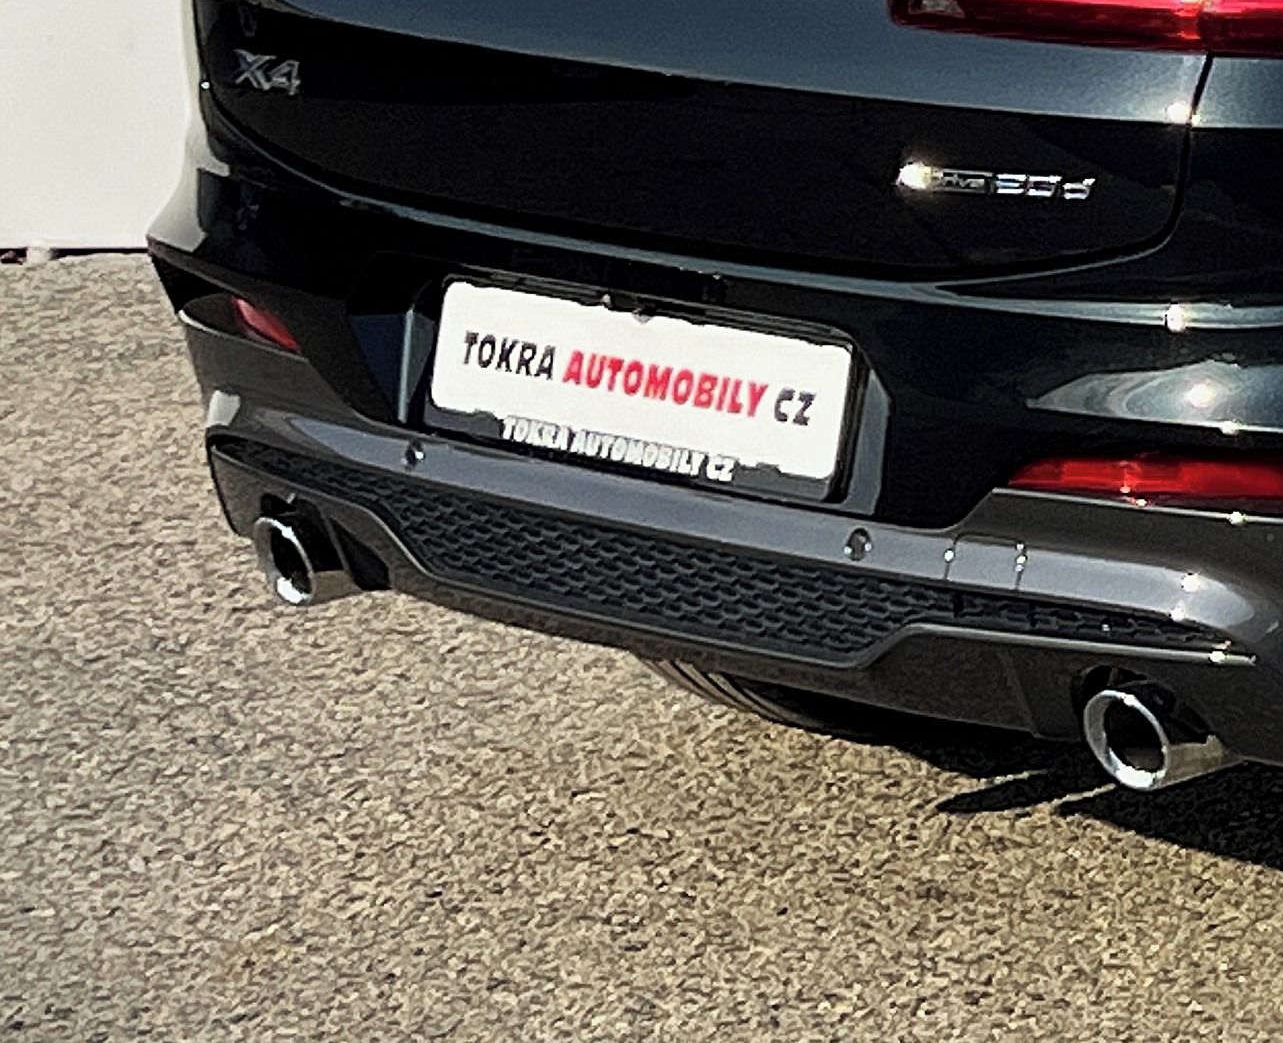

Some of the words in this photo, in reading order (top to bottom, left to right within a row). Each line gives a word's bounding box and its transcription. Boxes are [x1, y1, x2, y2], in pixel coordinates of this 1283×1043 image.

[231, 48, 302, 97] X4
[463, 329, 556, 381] TOKRA
[561, 348, 770, 418] AUTOMOBILY
[773, 385, 817, 427] CZ
[501, 415, 575, 452] TOKRA
[570, 428, 708, 478] AUTOMOBILY
[705, 453, 740, 483] CZ
